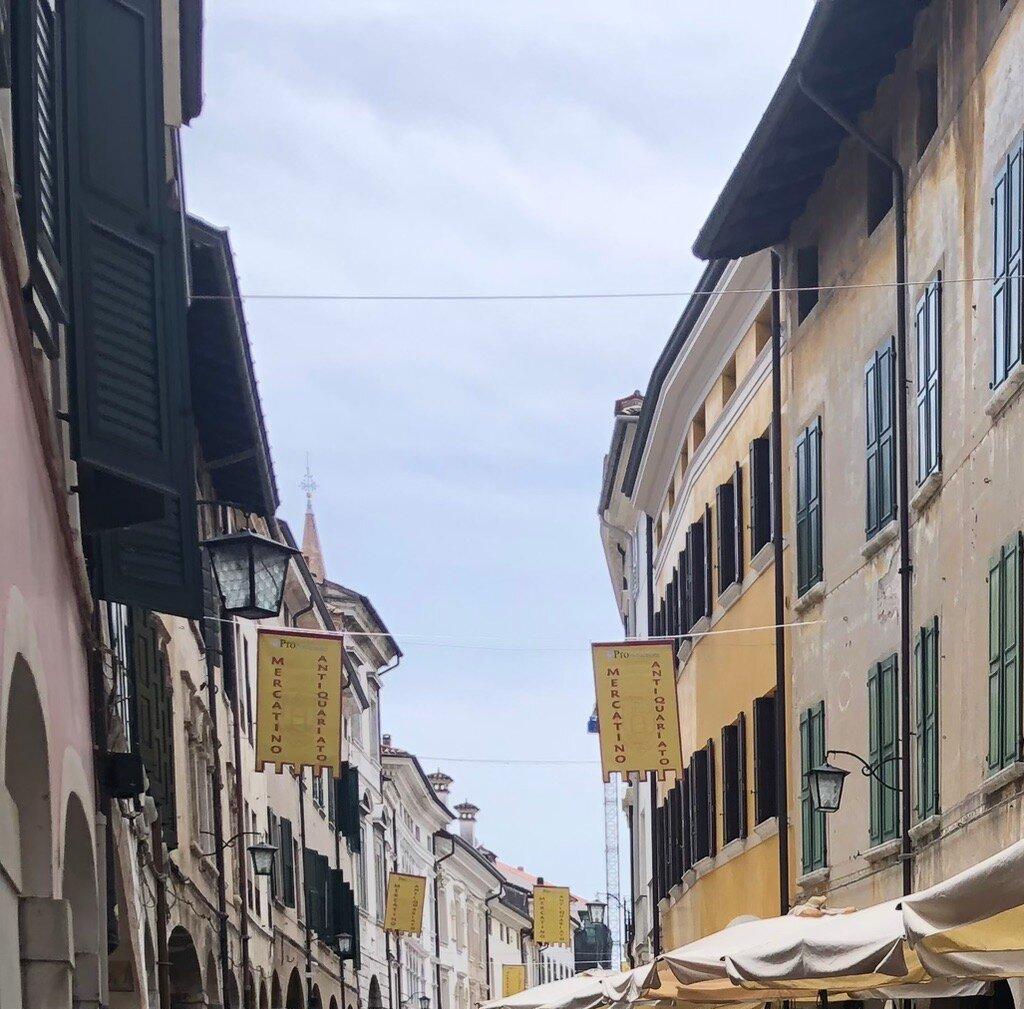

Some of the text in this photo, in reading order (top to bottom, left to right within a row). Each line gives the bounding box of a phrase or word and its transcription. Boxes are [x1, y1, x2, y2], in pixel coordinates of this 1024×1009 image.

[280, 638, 296, 649] Pro
[613, 650, 629, 659] Pro
[270, 656, 285, 754] MERCATINO
[316, 655, 329, 762] ANTIQUARIATO
[607, 668, 627, 763] MERCATINO
[651, 660, 670, 765] ANTIQUARIATO
